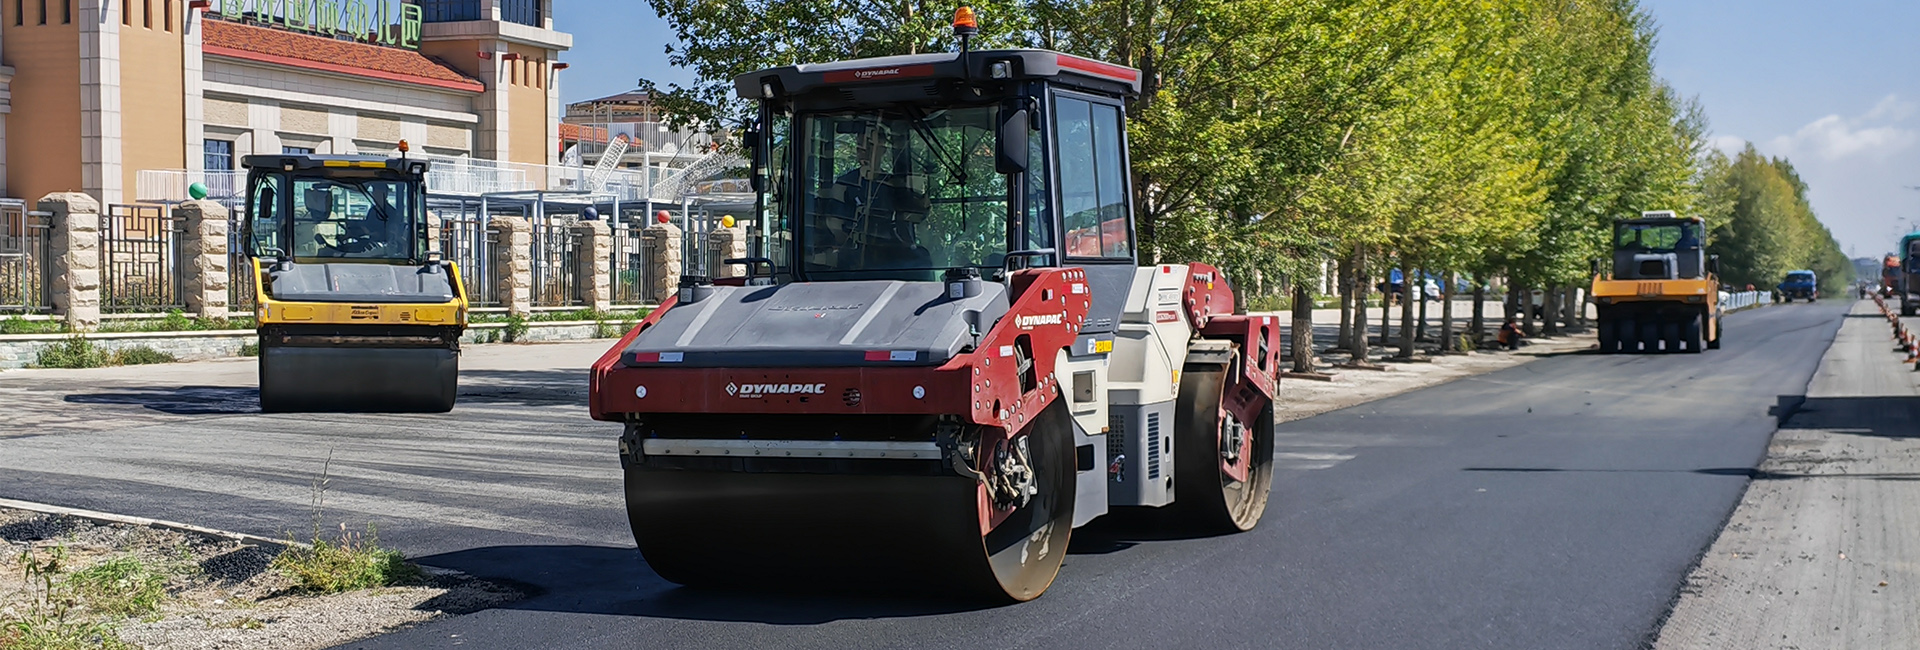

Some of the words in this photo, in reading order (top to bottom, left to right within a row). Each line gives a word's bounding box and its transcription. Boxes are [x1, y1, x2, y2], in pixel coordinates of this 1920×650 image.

[861, 68, 900, 76] DYNAPAC
[1021, 313, 1062, 326] DYNAPAC
[740, 383, 826, 394] DYNAPAC
